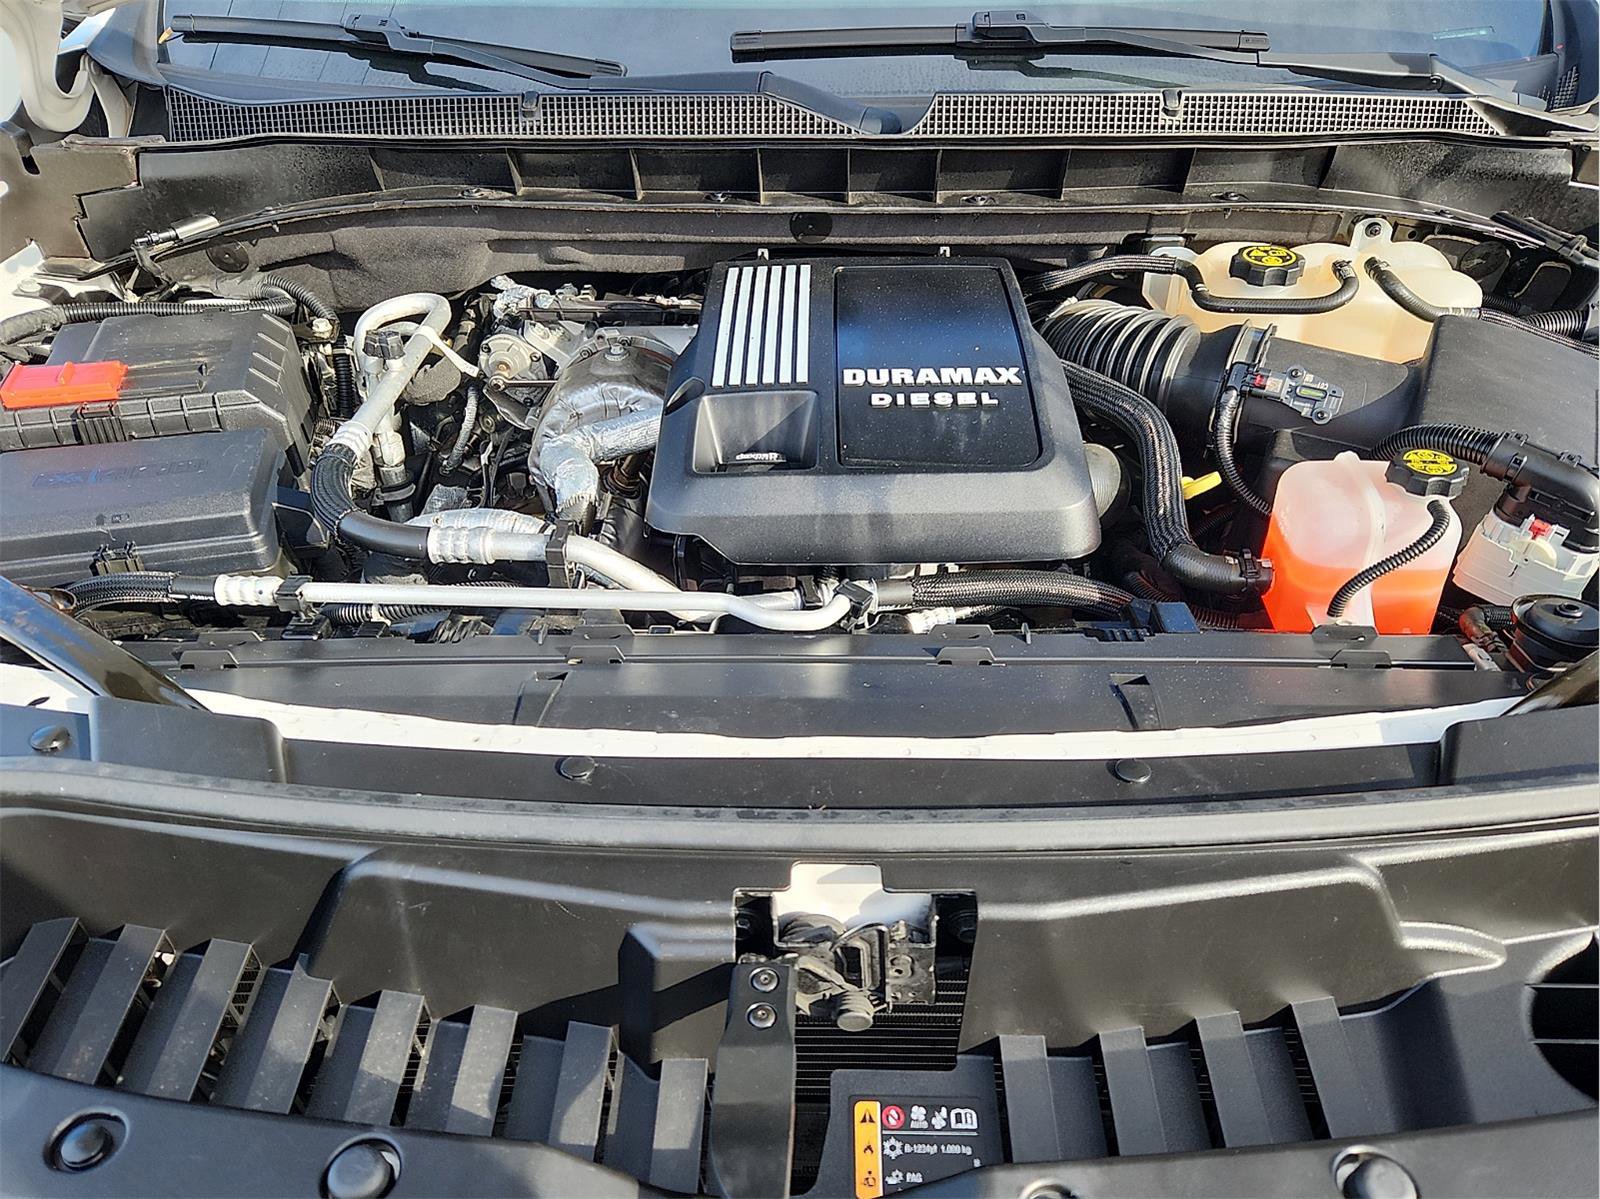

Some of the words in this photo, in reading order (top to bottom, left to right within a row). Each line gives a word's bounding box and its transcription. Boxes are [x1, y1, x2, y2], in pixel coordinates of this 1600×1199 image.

[843, 367, 1022, 386] DURAMAX
[870, 392, 999, 407] DIESEL
[906, 1172, 923, 1183] PAG
